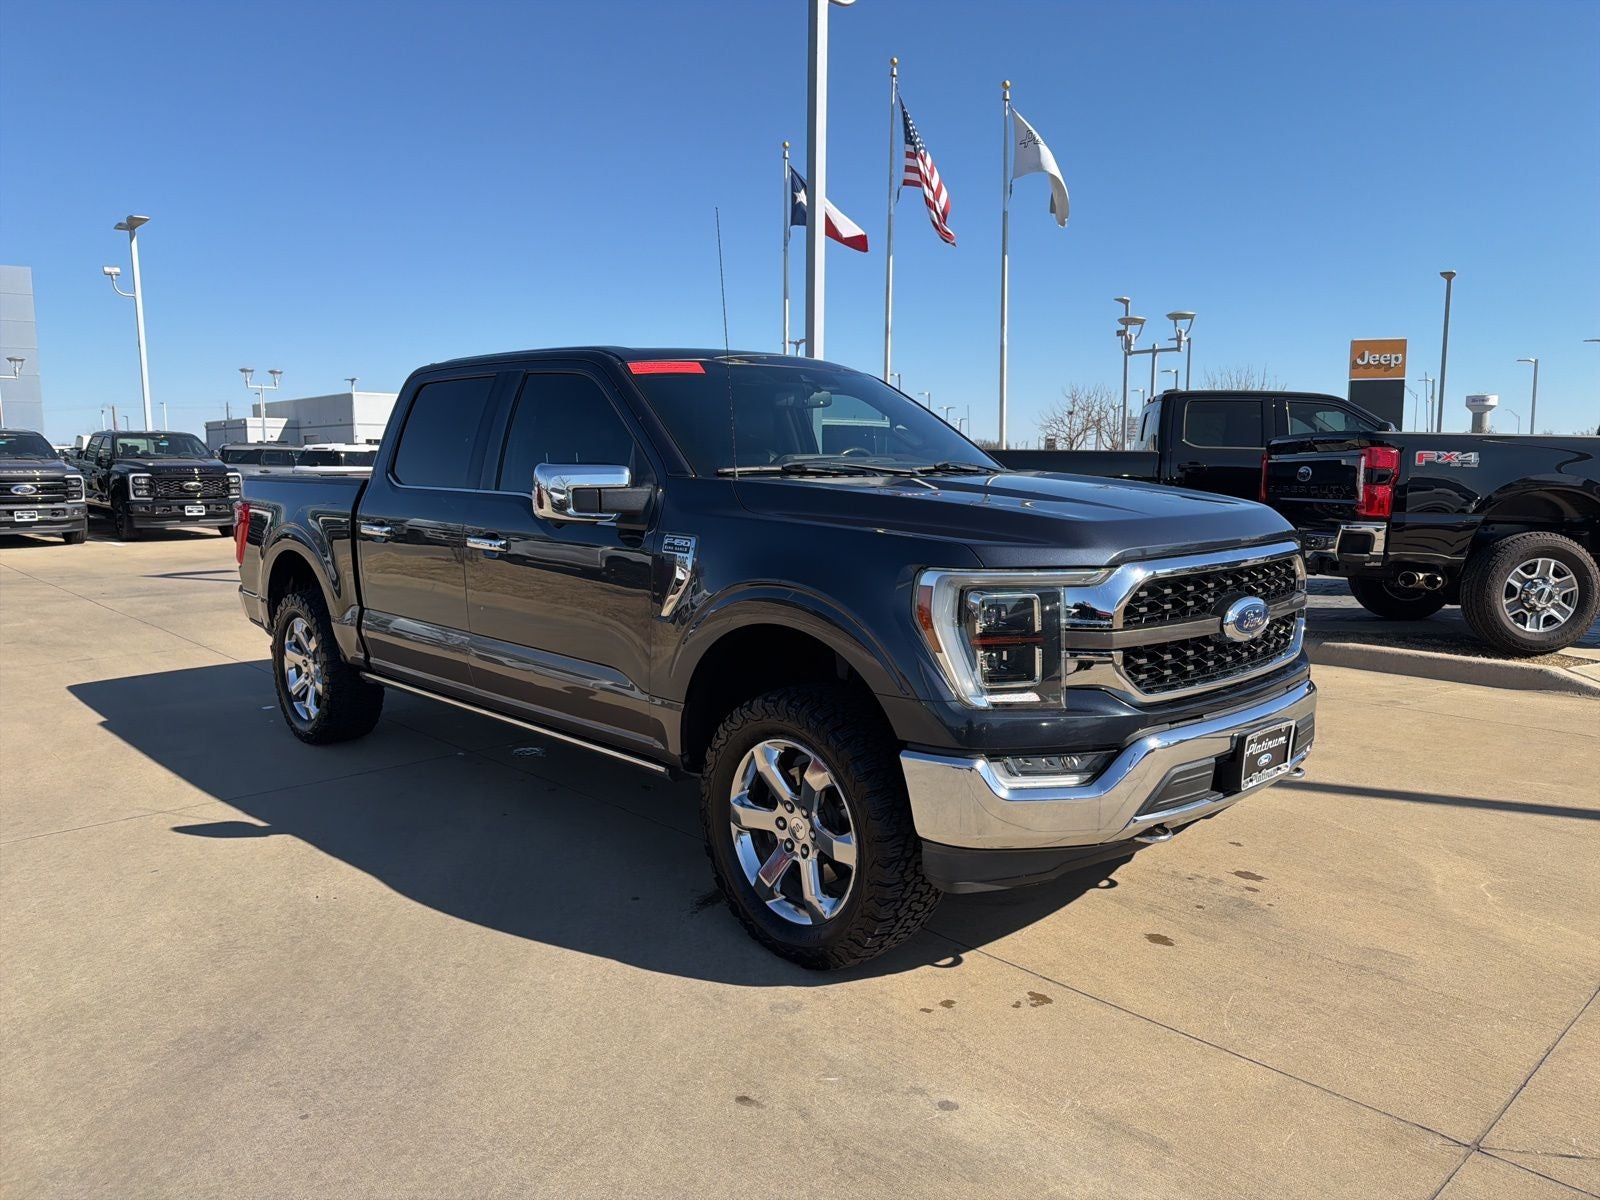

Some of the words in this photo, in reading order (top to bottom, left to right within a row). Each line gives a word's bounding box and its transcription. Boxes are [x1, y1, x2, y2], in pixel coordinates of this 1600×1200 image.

[1356, 350, 1403, 367] Jeep
[1414, 450, 1479, 466] FX4
[1246, 736, 1287, 757] Platinum
